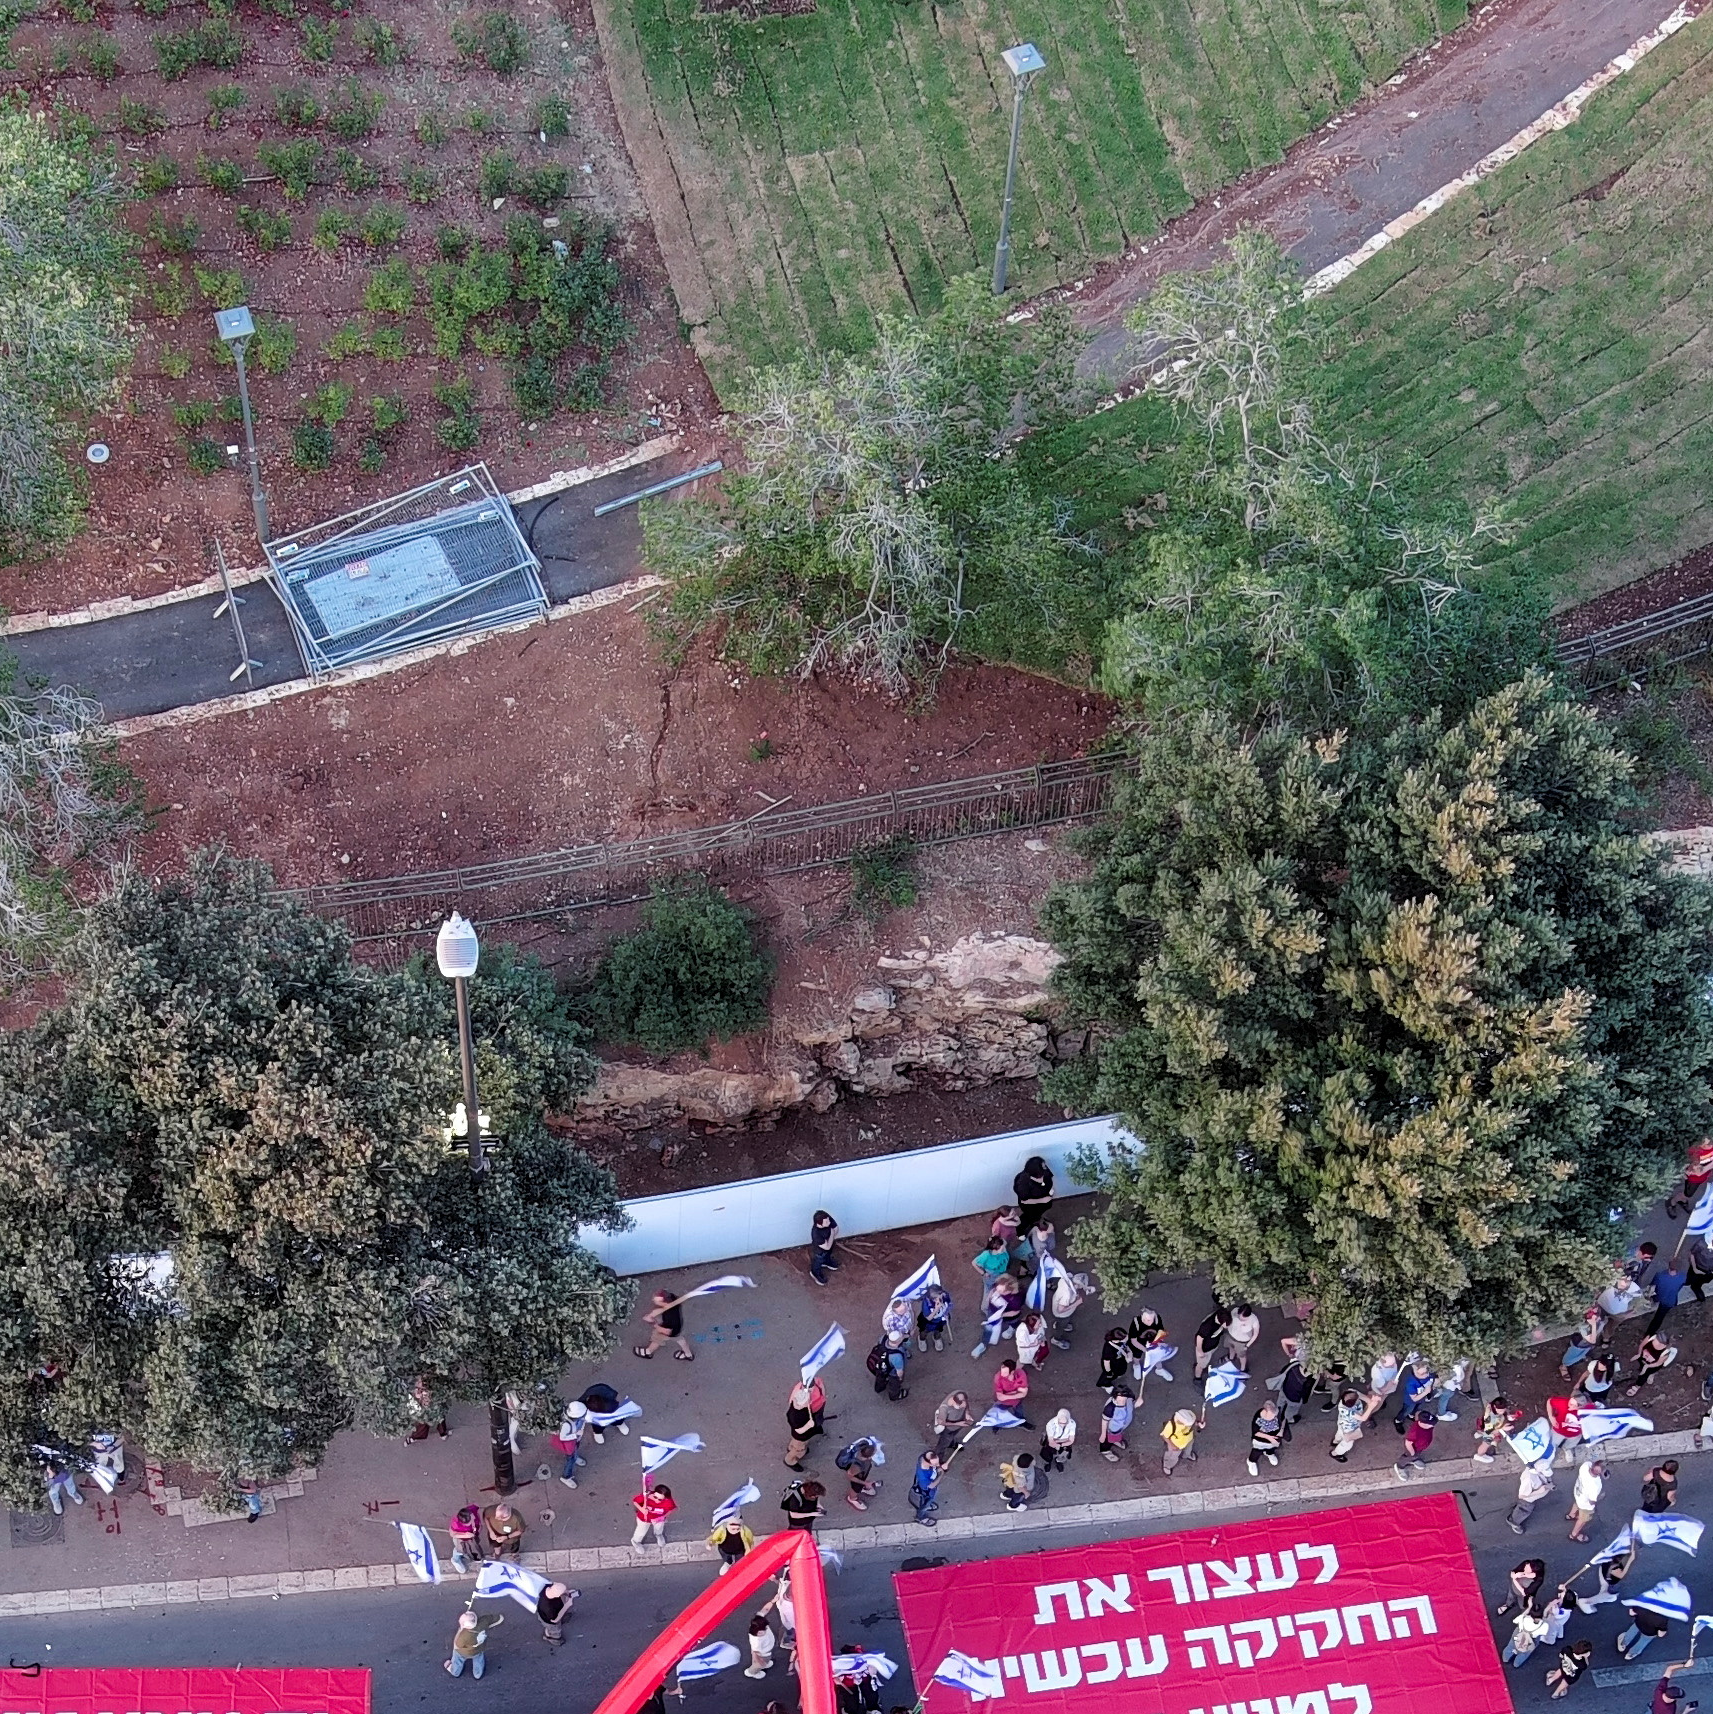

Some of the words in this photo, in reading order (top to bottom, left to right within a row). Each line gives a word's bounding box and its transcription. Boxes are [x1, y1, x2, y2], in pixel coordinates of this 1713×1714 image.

[1034, 1574, 1134, 1624] את
[1147, 1543, 1339, 1604] לעצור
[1184, 1595, 1437, 1668] החקיקה
